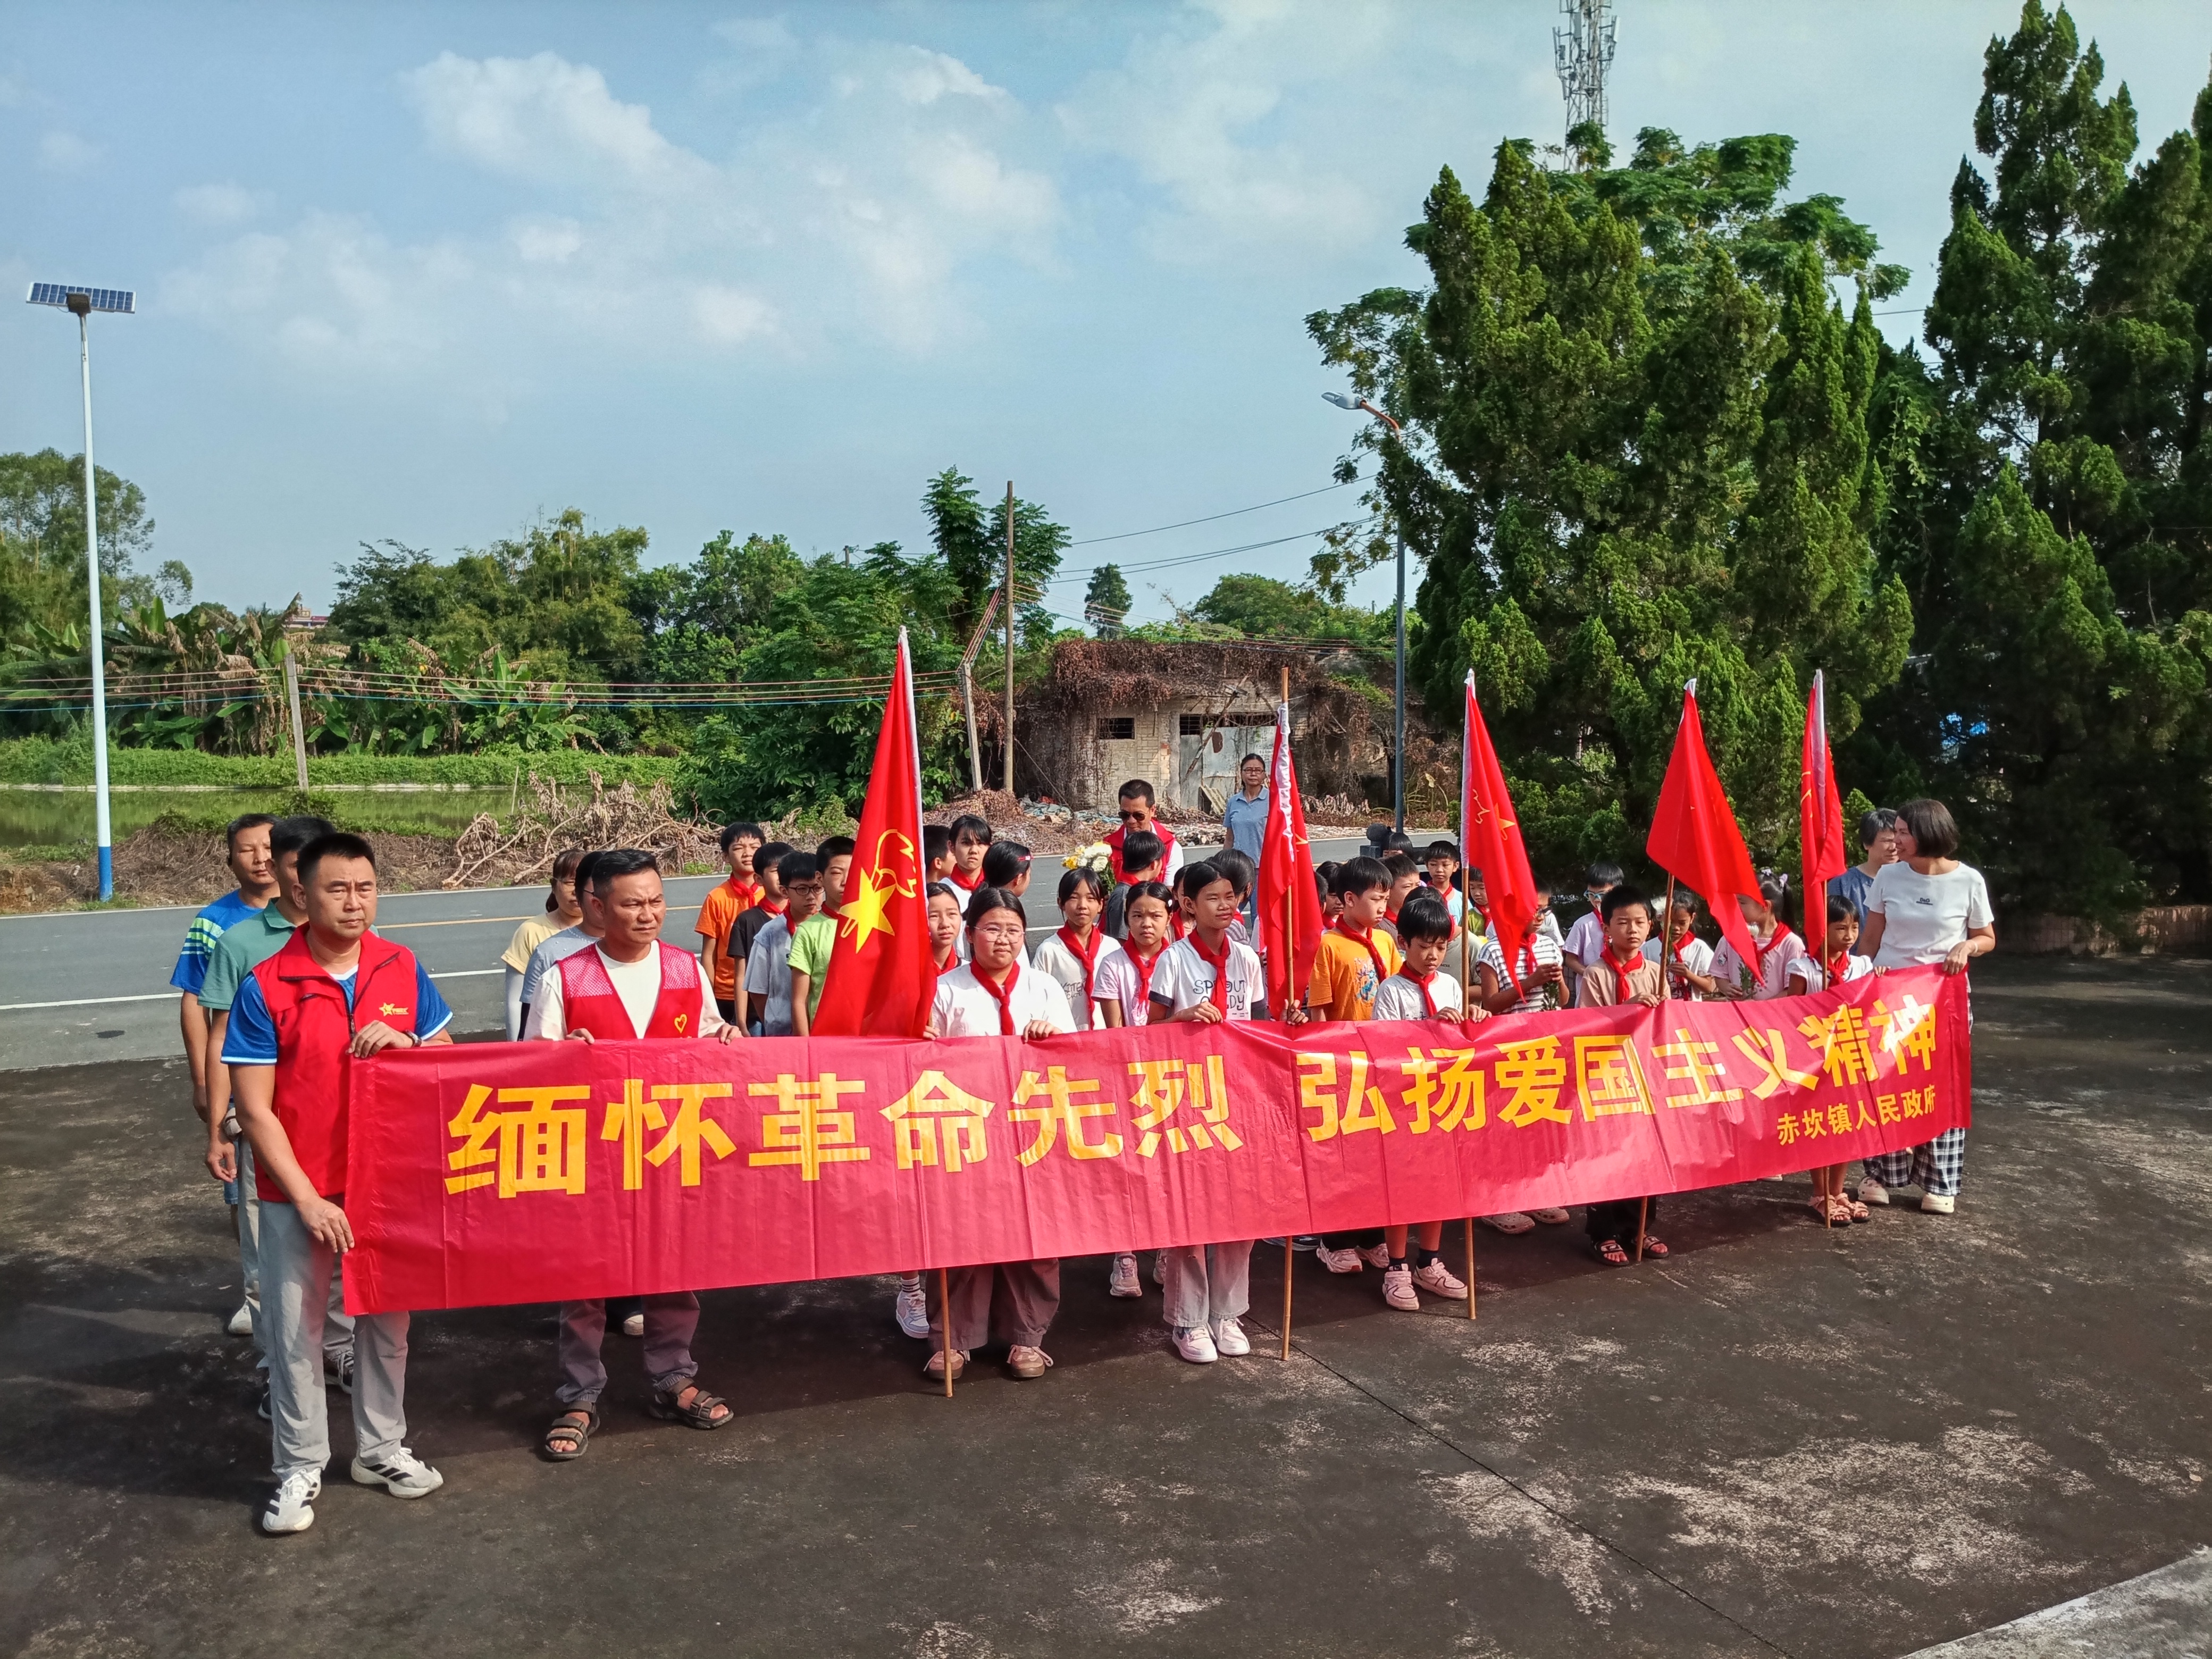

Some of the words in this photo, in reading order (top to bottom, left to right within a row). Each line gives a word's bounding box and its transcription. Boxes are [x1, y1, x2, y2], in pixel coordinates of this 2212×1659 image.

[1193, 979, 1245, 994] SPOUT
[444, 1054, 1243, 1199] 缅怀革命先烈
[1296, 994, 1937, 1142] 弘扬爱国主义精神
[1777, 1084, 1936, 1145] 赤坎镇人民政府
